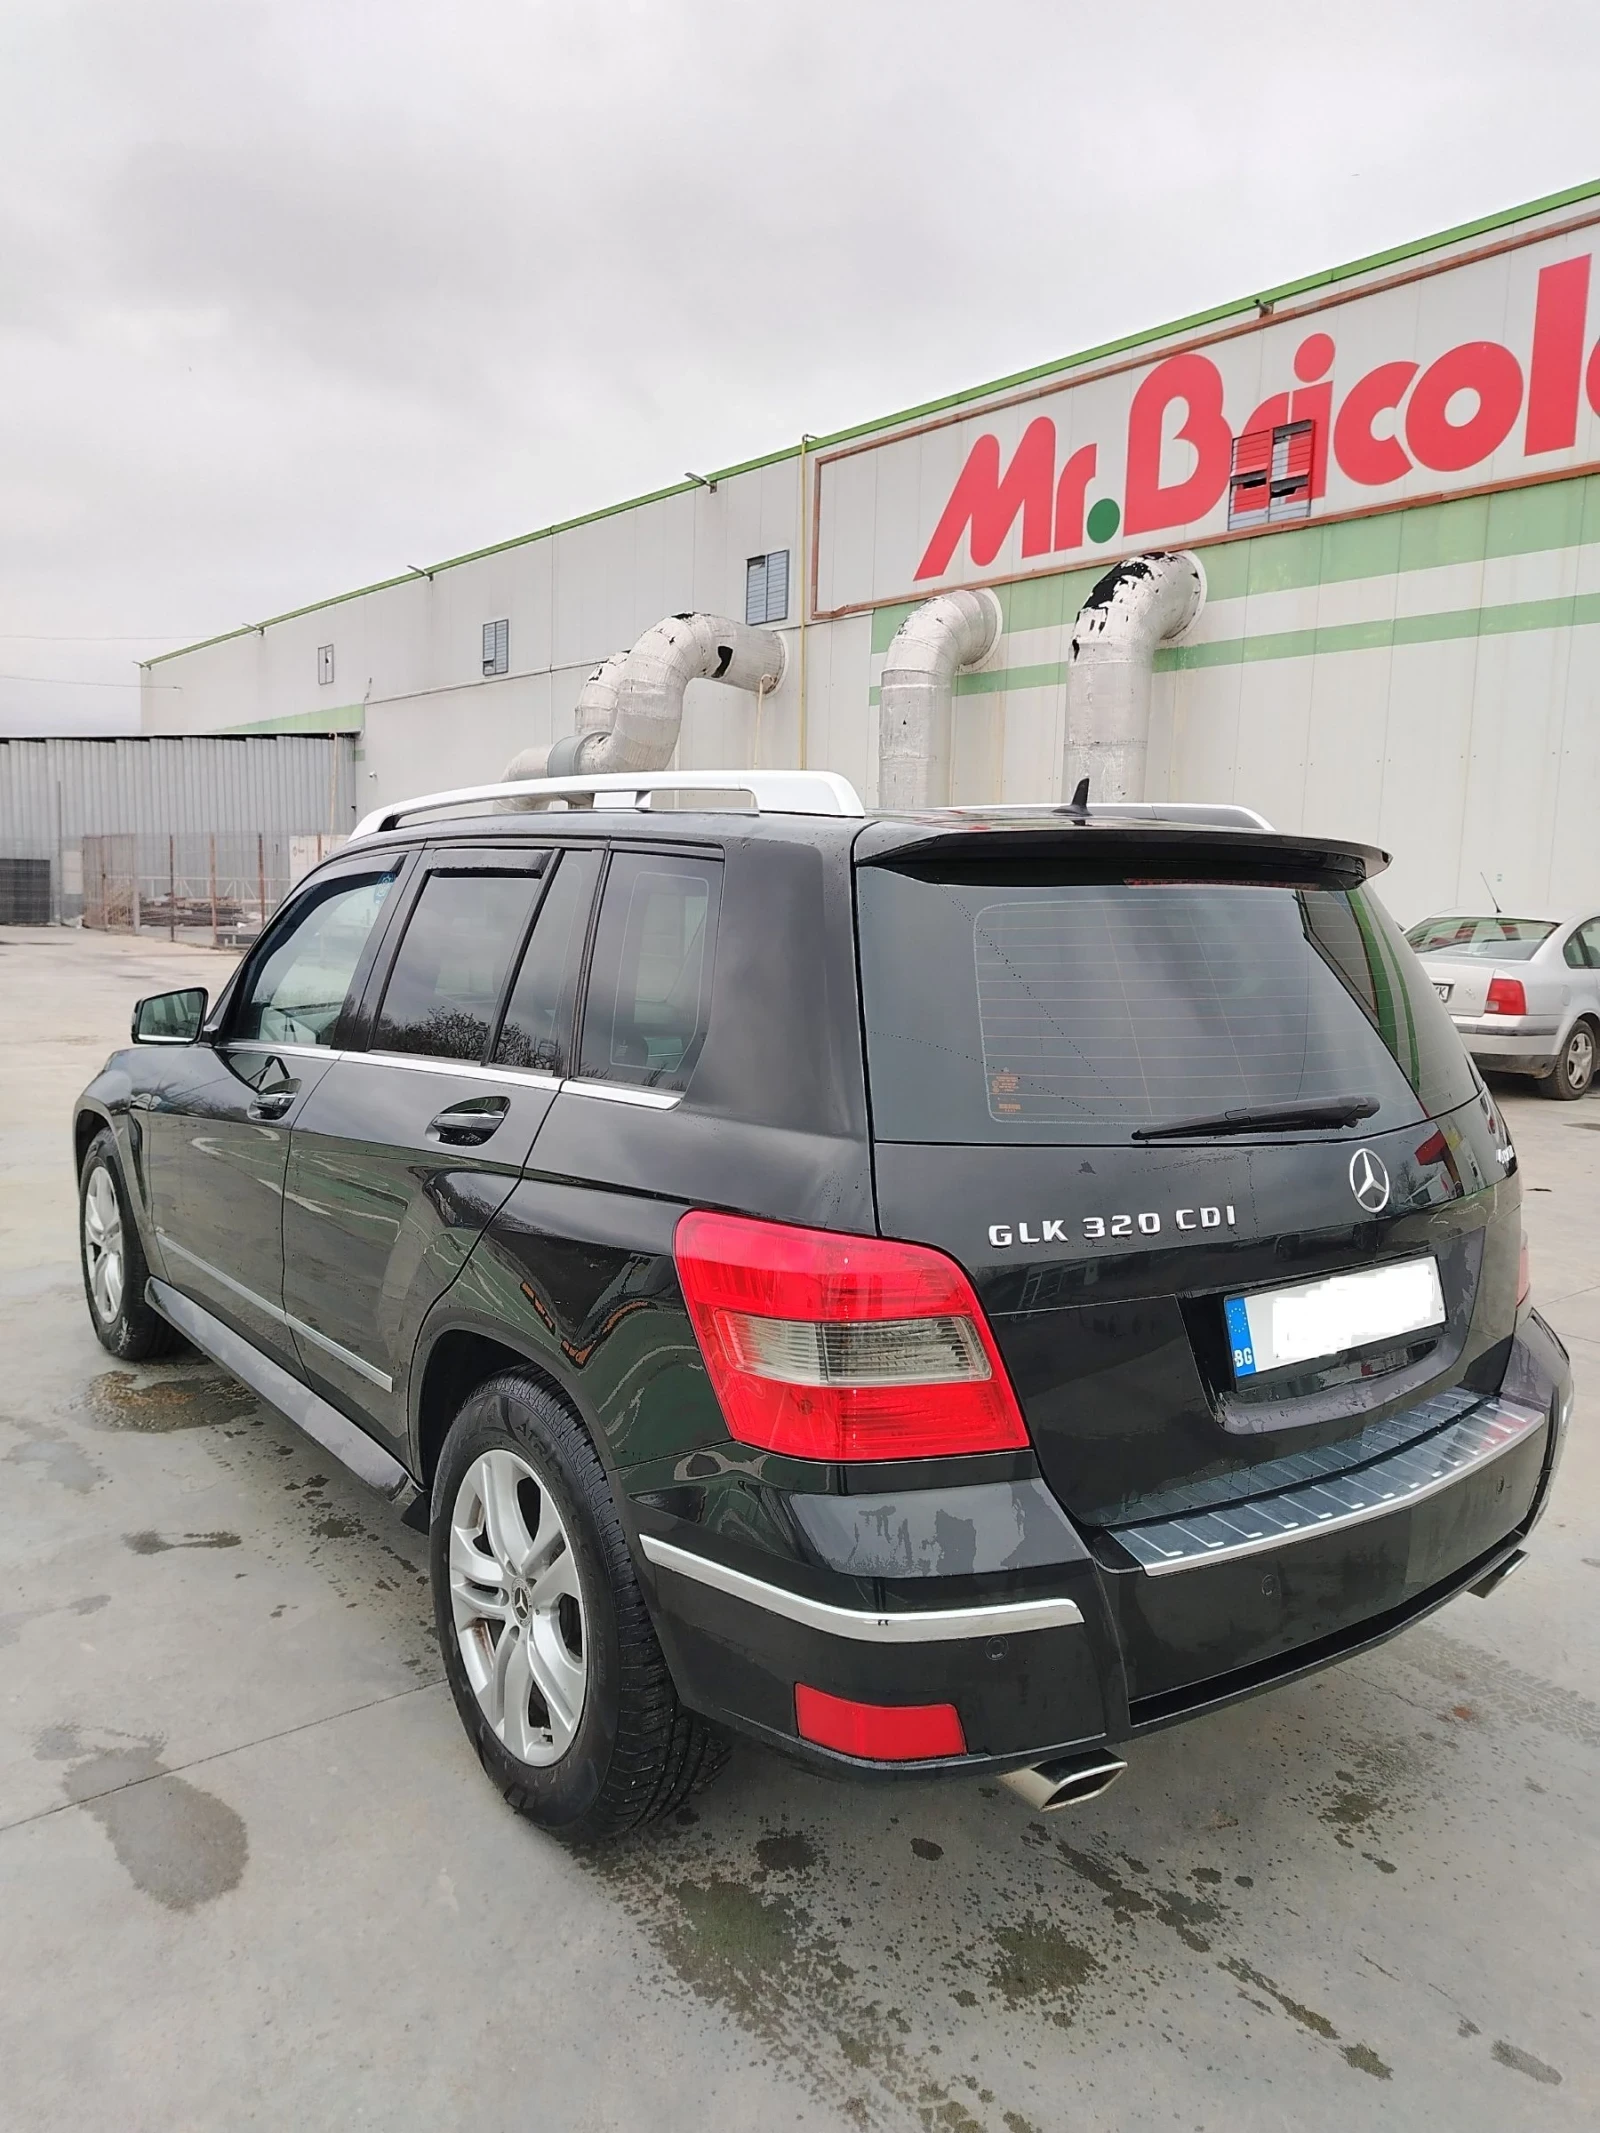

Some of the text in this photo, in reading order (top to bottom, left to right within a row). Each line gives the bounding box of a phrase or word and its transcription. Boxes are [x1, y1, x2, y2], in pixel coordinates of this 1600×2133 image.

[988, 1205, 1236, 1248] GLK 320 CDI
[1233, 1346, 1253, 1368] BG
